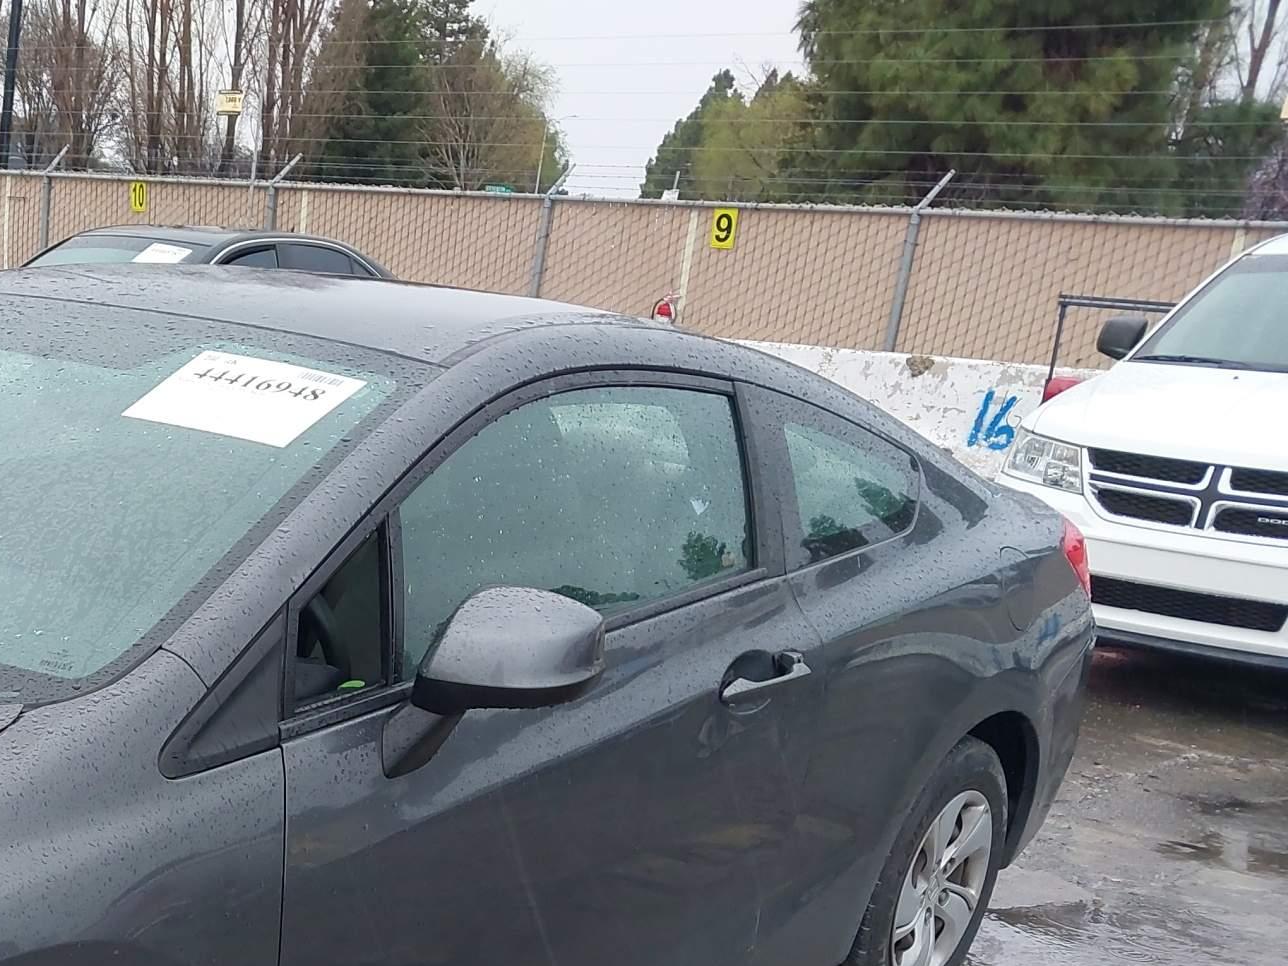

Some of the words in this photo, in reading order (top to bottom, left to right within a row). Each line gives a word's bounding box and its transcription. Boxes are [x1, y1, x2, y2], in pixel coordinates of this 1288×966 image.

[132, 183, 145, 207] 10
[715, 213, 732, 243] 9
[193, 367, 326, 401] 44416948
[967, 390, 1017, 450] 16
